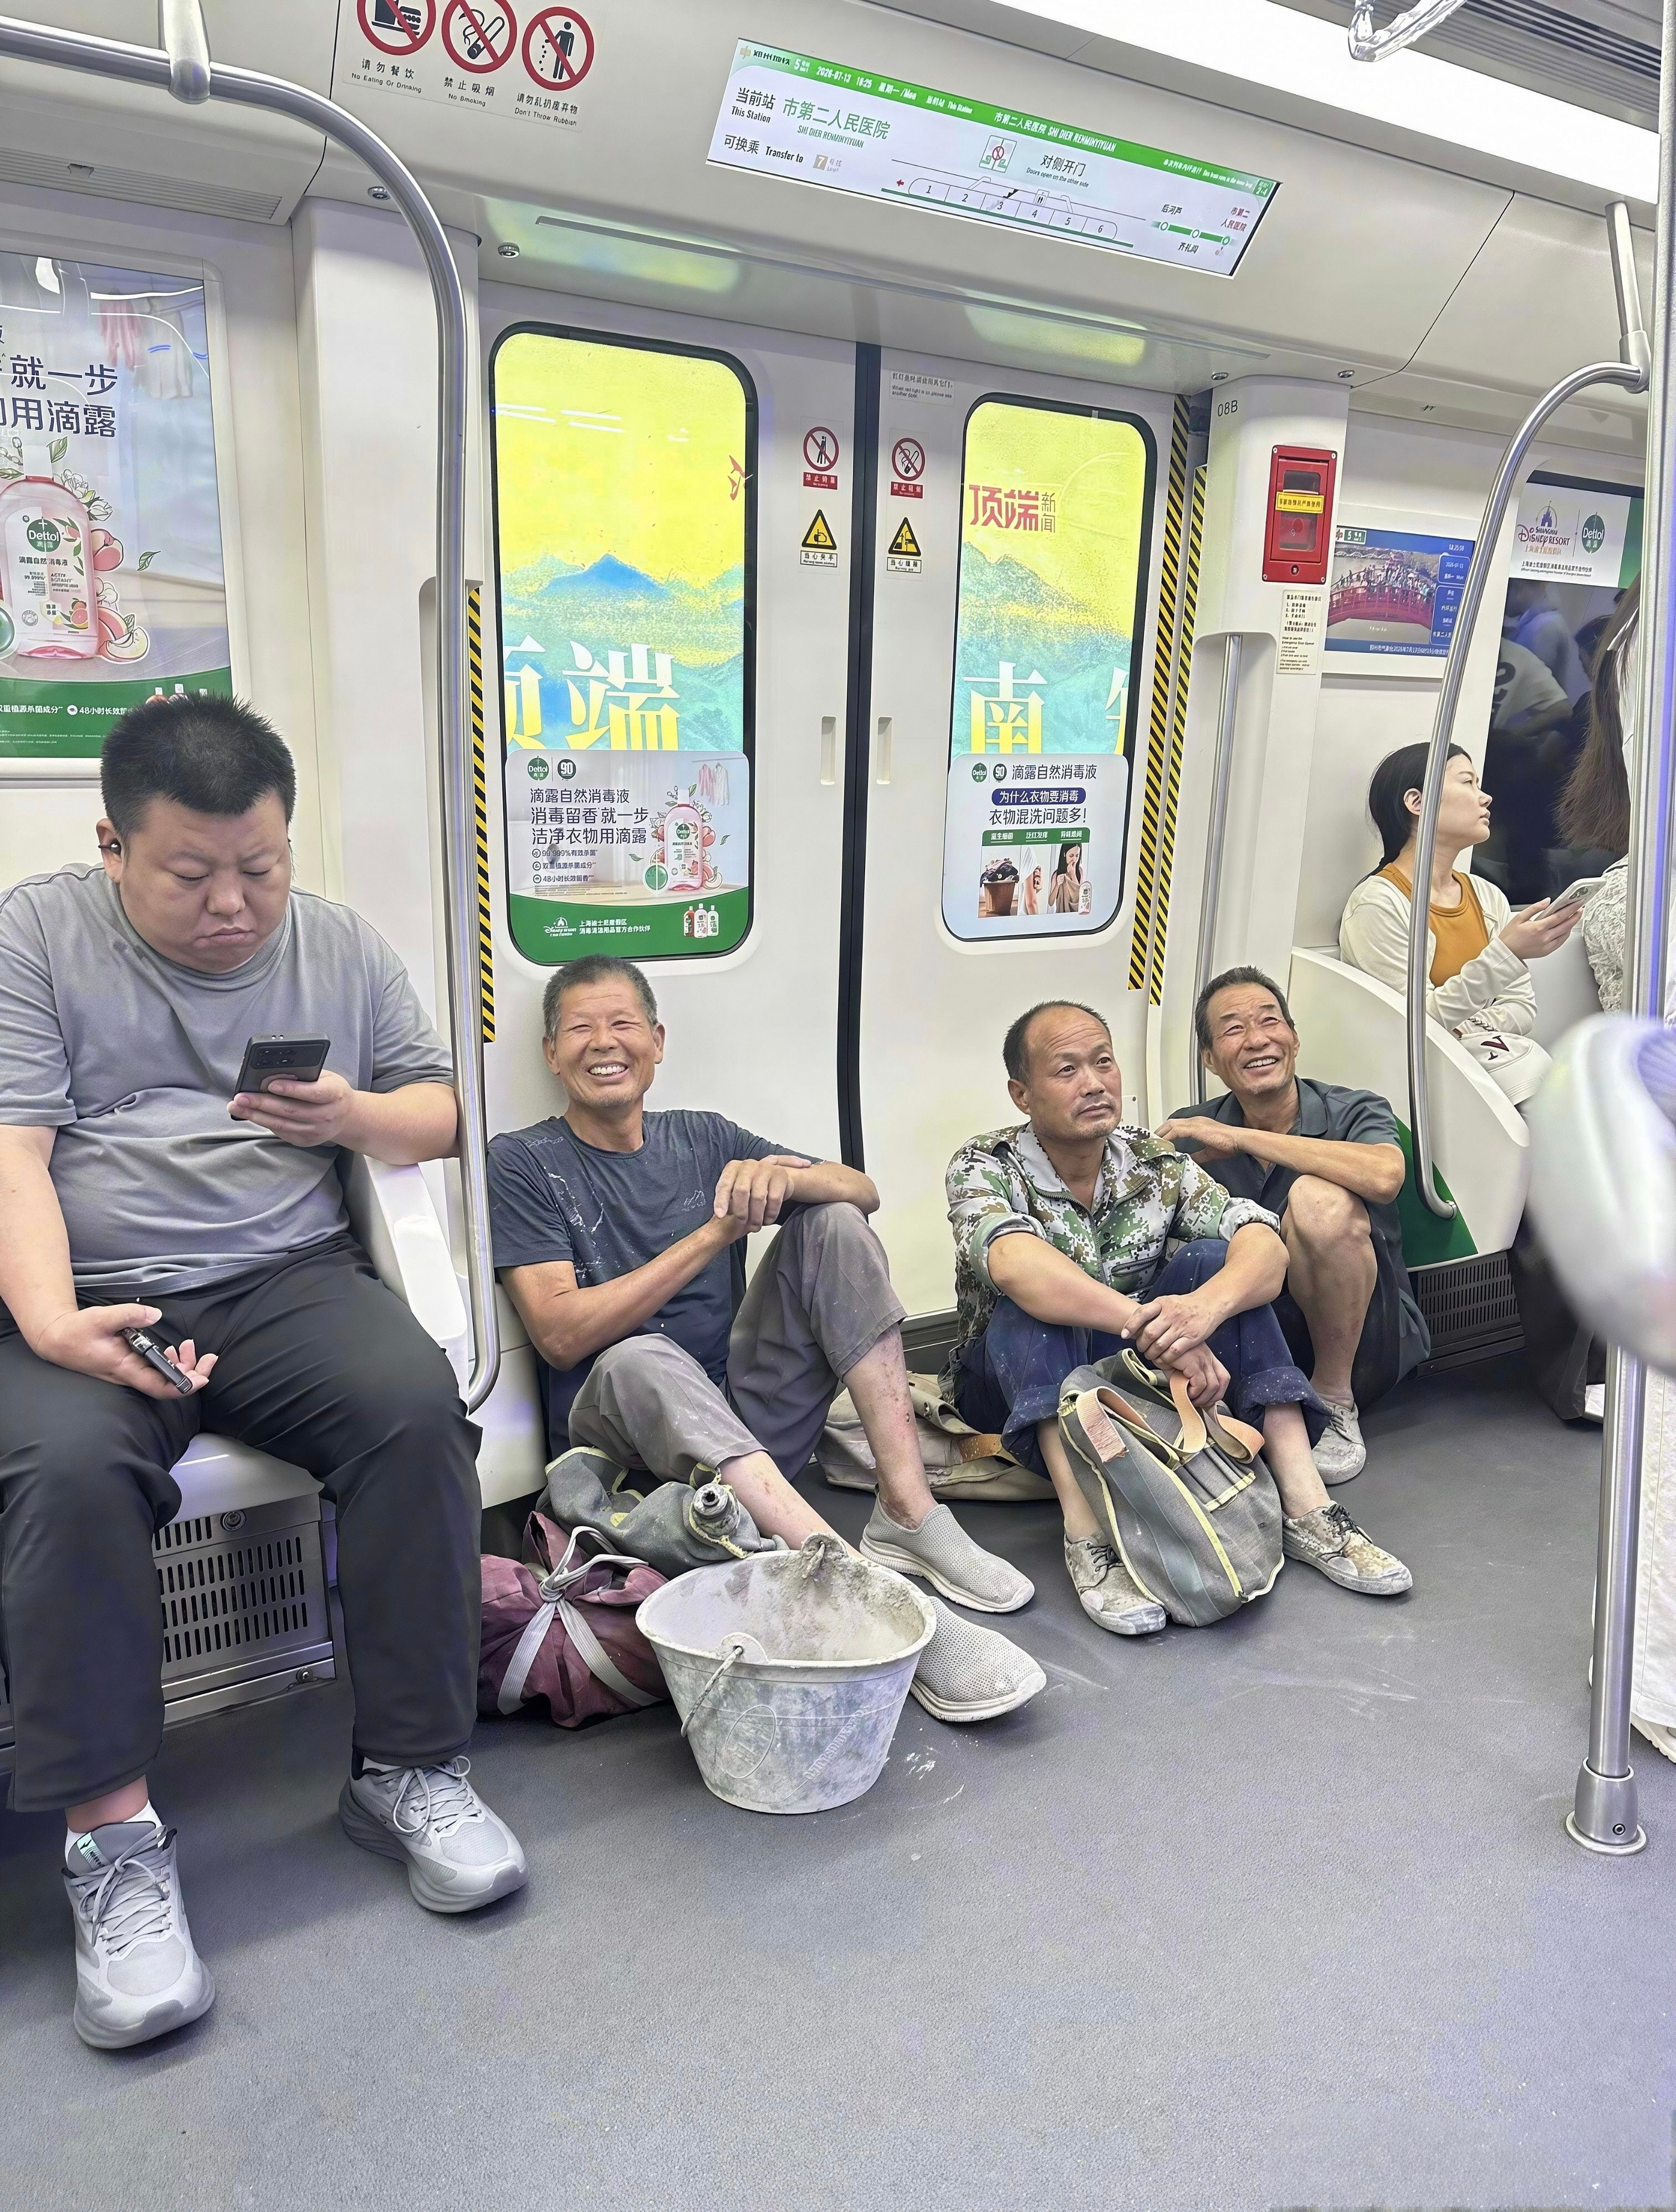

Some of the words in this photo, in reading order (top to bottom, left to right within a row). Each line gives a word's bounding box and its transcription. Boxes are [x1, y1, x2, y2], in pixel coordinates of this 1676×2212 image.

[361, 58, 415, 80] 请勿餐饮
[794, 58, 801, 70] 5
[364, 75, 383, 85] Eating
[397, 82, 421, 94] Drinking
[443, 76, 495, 96] 禁止吸烟
[460, 95, 486, 107] Smoking
[517, 93, 578, 115] 请勿乱扔废弃物
[735, 87, 776, 110] 当前站
[514, 107, 530, 117] Don't
[534, 111, 551, 121] Throw
[554, 116, 577, 126] Rubbish
[731, 106, 745, 118] This
[747, 110, 771, 124] Station
[782, 98, 891, 140] 市第二人民医院
[809, 127, 822, 139] DIER
[994, 112, 1048, 134] 市第二人民医院
[1048, 126, 1059, 137] SHI
[1059, 129, 1074, 141] DIER
[1074, 133, 1117, 152] RENMINYIYUAN
[724, 134, 760, 155] 可换乘
[765, 146, 795, 162] Transfer
[796, 153, 804, 163] to
[817, 156, 825, 167] 7
[1026, 167, 1040, 176] Doors
[1041, 172, 1052, 181] open
[1040, 155, 1086, 177] 对侧开门
[926, 185, 932, 194] 1
[961, 193, 969, 202] 2
[997, 201, 1004, 211] 3
[1031, 209, 1038, 218] 4
[1064, 217, 1071, 226] 5
[1097, 225, 1104, 234] 6
[1230, 207, 1250, 218] 市第二
[1220, 218, 1247, 232] 人民医院
[0, 355, 117, 396] 就一步
[1217, 400, 1239, 417] 08B
[969, 484, 1039, 531] 顶端
[1041, 491, 1056, 533] 新闻
[28, 530, 59, 542] Dettol
[1347, 531, 1351, 540] 5
[1535, 526, 1558, 536] SHANGHAI
[1582, 527, 1604, 540] Dettol
[1549, 536, 1570, 546] RESORT
[963, 660, 1047, 754] 南
[560, 762, 573, 774] 90
[1011, 764, 1097, 780] 滴露自然消毒液
[530, 788, 630, 803] 滴露自然消毒液
[999, 790, 1079, 803] 为什么衣物要消毒
[531, 807, 649, 825] 消毒留香就一步
[989, 807, 1087, 825] 衣物混洗问题多!
[532, 827, 647, 845] 洁净衣物用滴露
